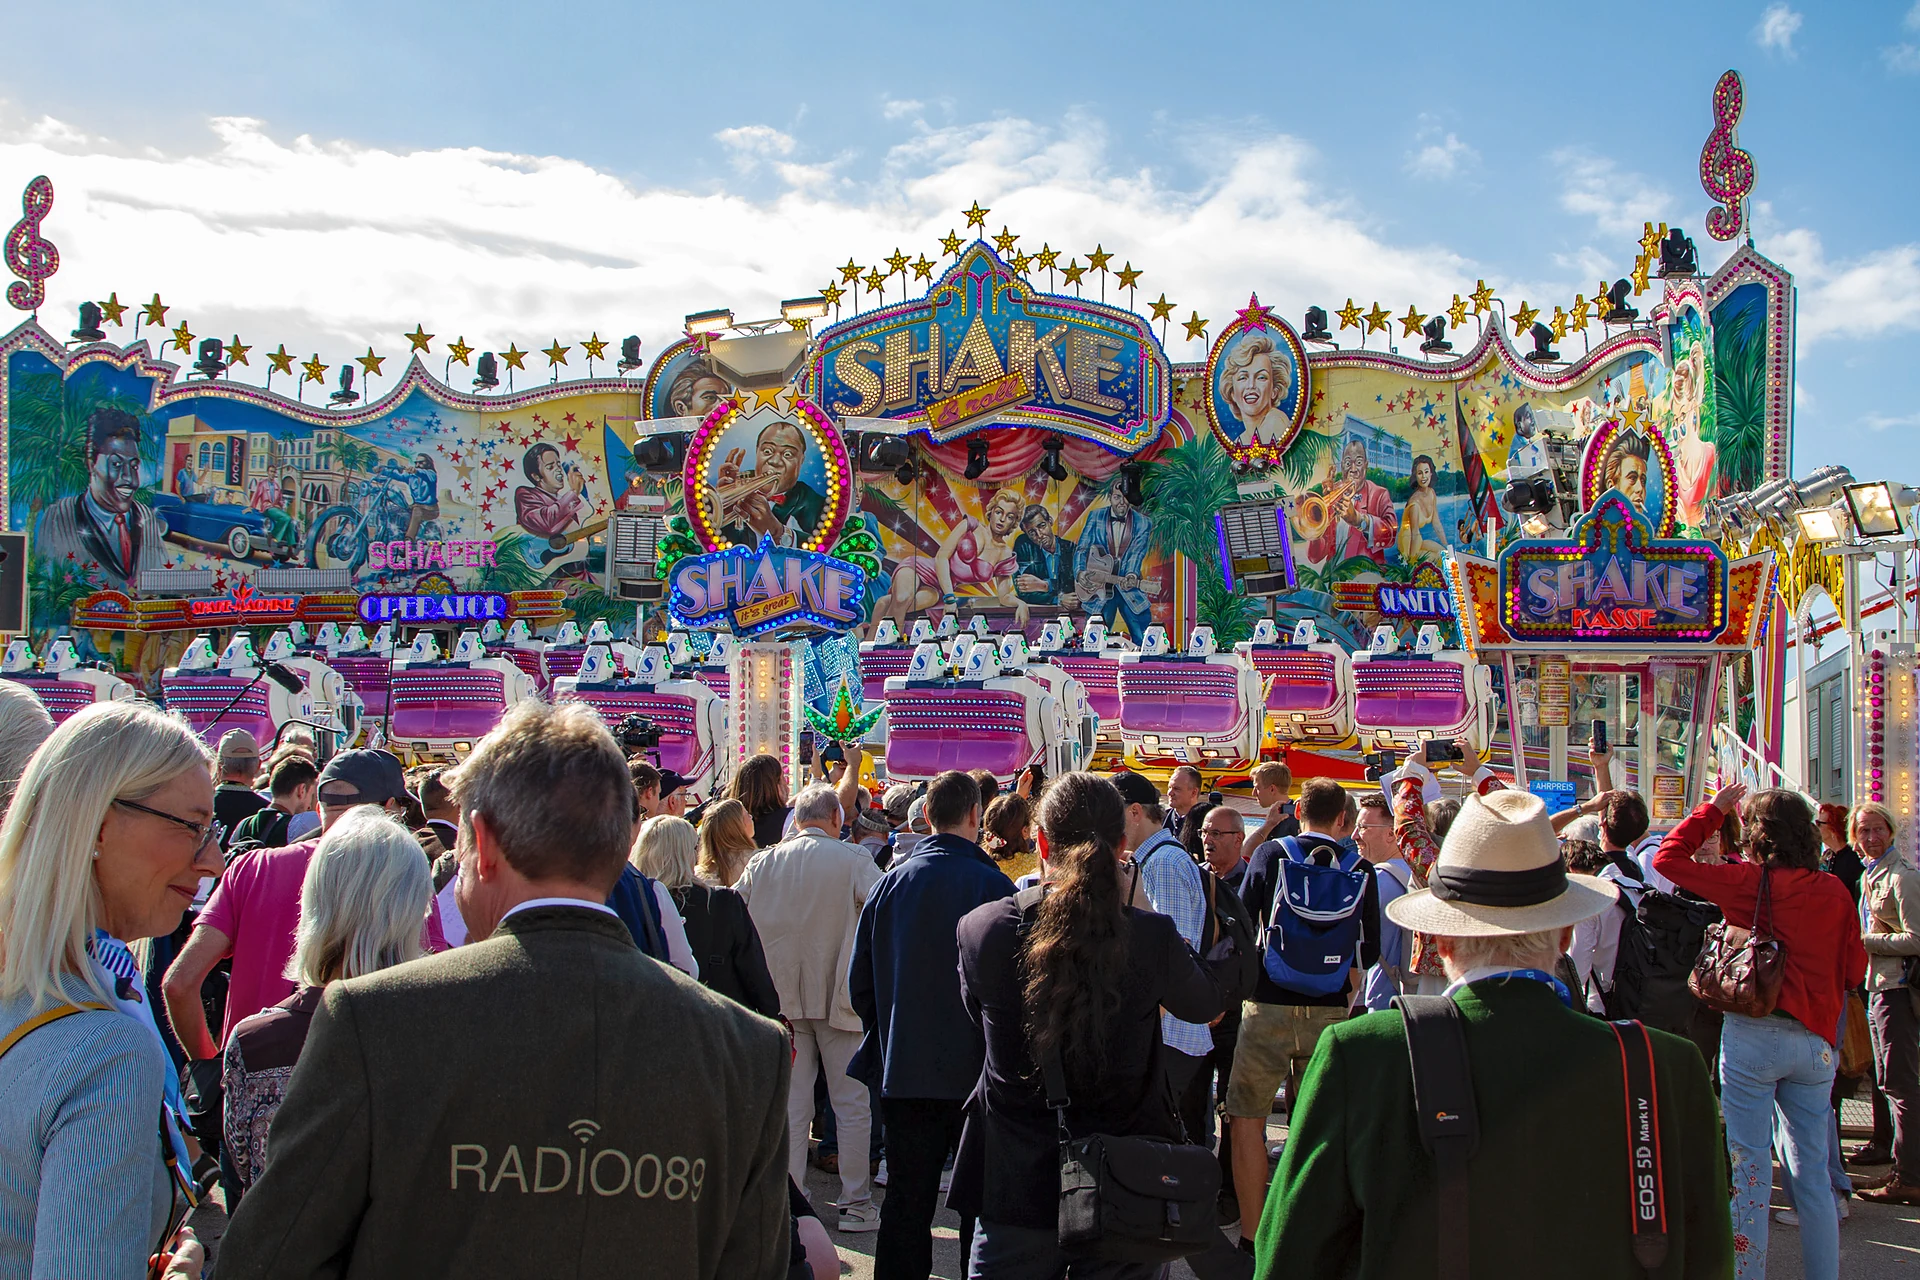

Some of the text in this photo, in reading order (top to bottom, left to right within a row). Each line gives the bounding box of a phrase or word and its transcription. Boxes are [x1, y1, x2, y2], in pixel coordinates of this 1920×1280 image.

[832, 311, 1127, 417] SHAKE
[937, 377, 1019, 425] & roll
[360, 595, 506, 622] OPERATOR
[676, 551, 857, 619] SHAKE
[740, 595, 790, 622] it's great
[1380, 587, 1436, 614] SUNSET
[1528, 554, 1699, 616] SHAKE
[1571, 607, 1658, 630] KASSE
[1636, 1097, 1656, 1221] EOS 5D Mark IV
